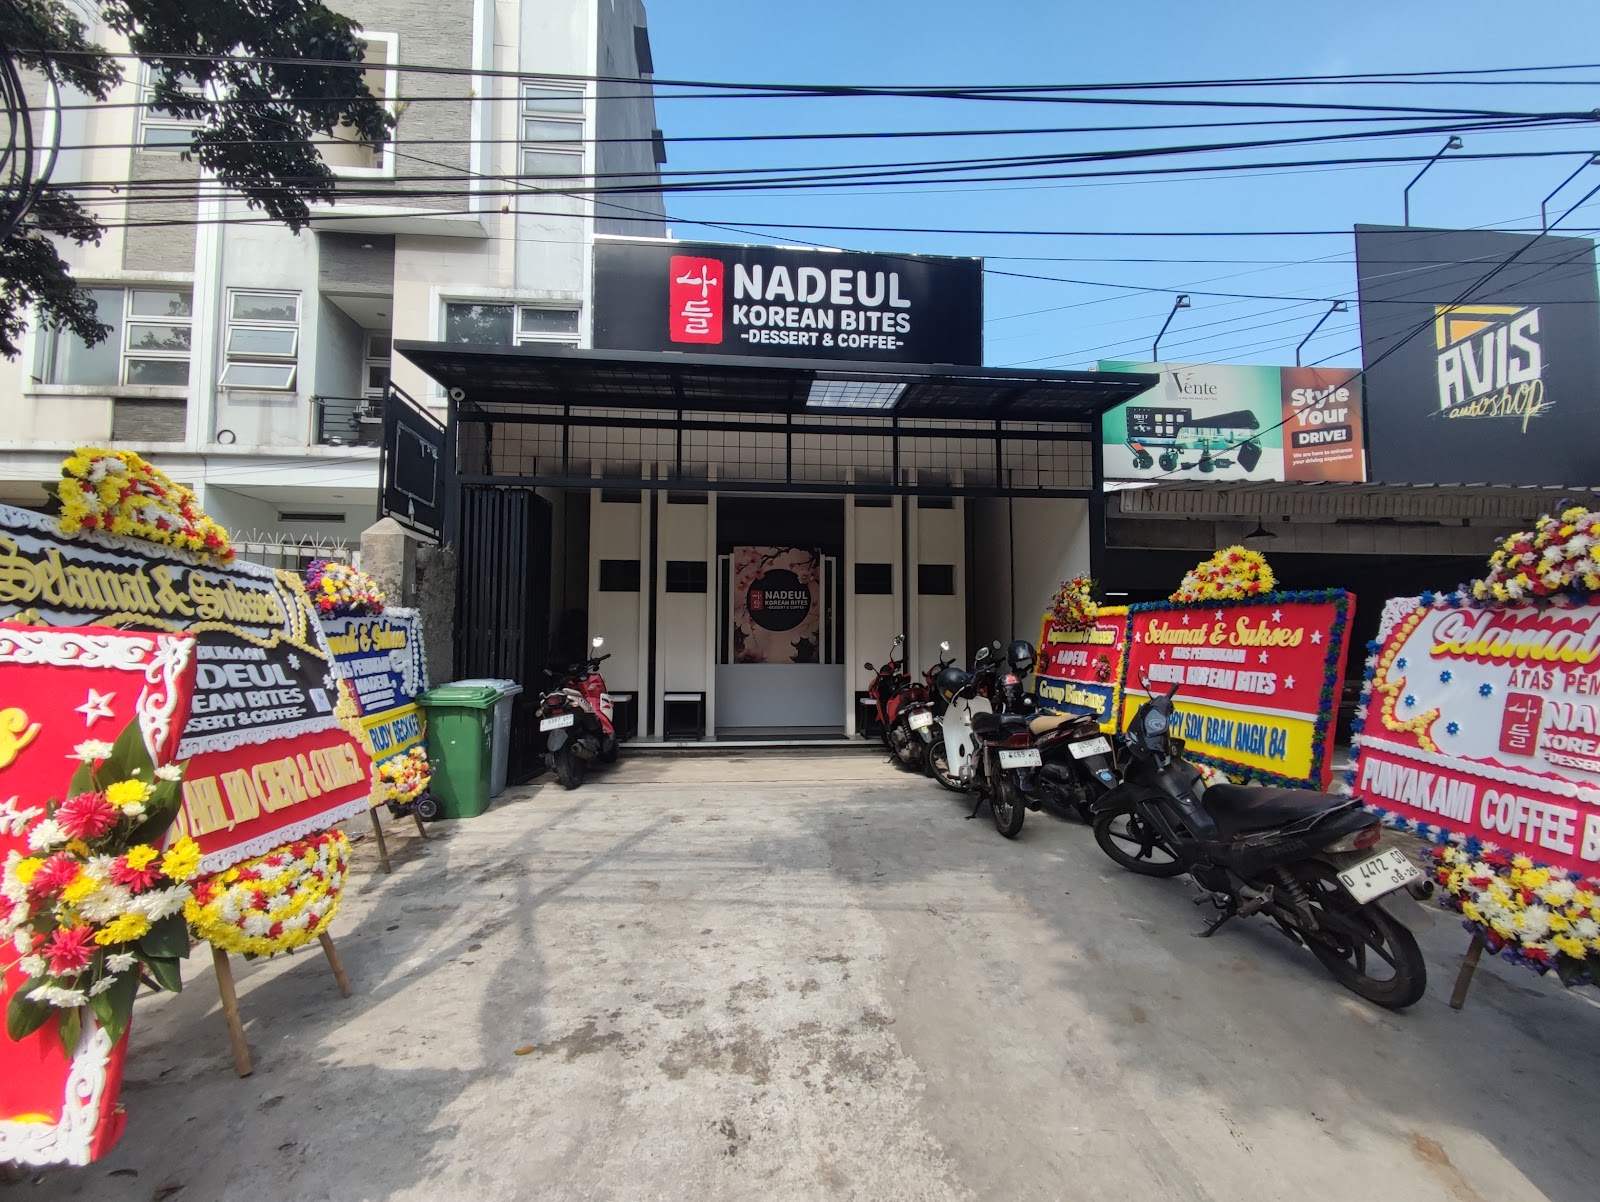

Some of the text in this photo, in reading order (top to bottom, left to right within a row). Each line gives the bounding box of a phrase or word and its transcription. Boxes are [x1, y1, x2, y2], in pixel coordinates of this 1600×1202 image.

[733, 263, 911, 308] NADEUL
[733, 304, 911, 334] KOREAN BITES
[822, 332, 834, 347] &
[1438, 307, 1542, 411] AVIS
[1171, 372, 1218, 395] Vente
[1291, 384, 1350, 409] Style
[1293, 408, 1348, 427] Your
[1298, 428, 1347, 445] DRIVE!
[150, 564, 195, 616] &
[764, 590, 809, 600] NADEUL
[1144, 615, 1305, 647] Selamat & Sukses
[1056, 649, 1088, 667] NADEUL
[1185, 665, 1236, 691] KOREAN
[1234, 670, 1277, 696] BITES
[1507, 668, 1554, 691] ATAS
[245, 688, 305, 708] BITES
[1039, 679, 1107, 714] Group Bintang
[237, 711, 252, 725] &
[368, 722, 395, 753] RUDY
[1268, 726, 1288, 760] 84
[1360, 756, 1477, 824] PUNYAKAMI
[1479, 789, 1577, 856] COFFEE
[1341, 874, 1355, 888] D
[1360, 858, 1389, 879] 4472
